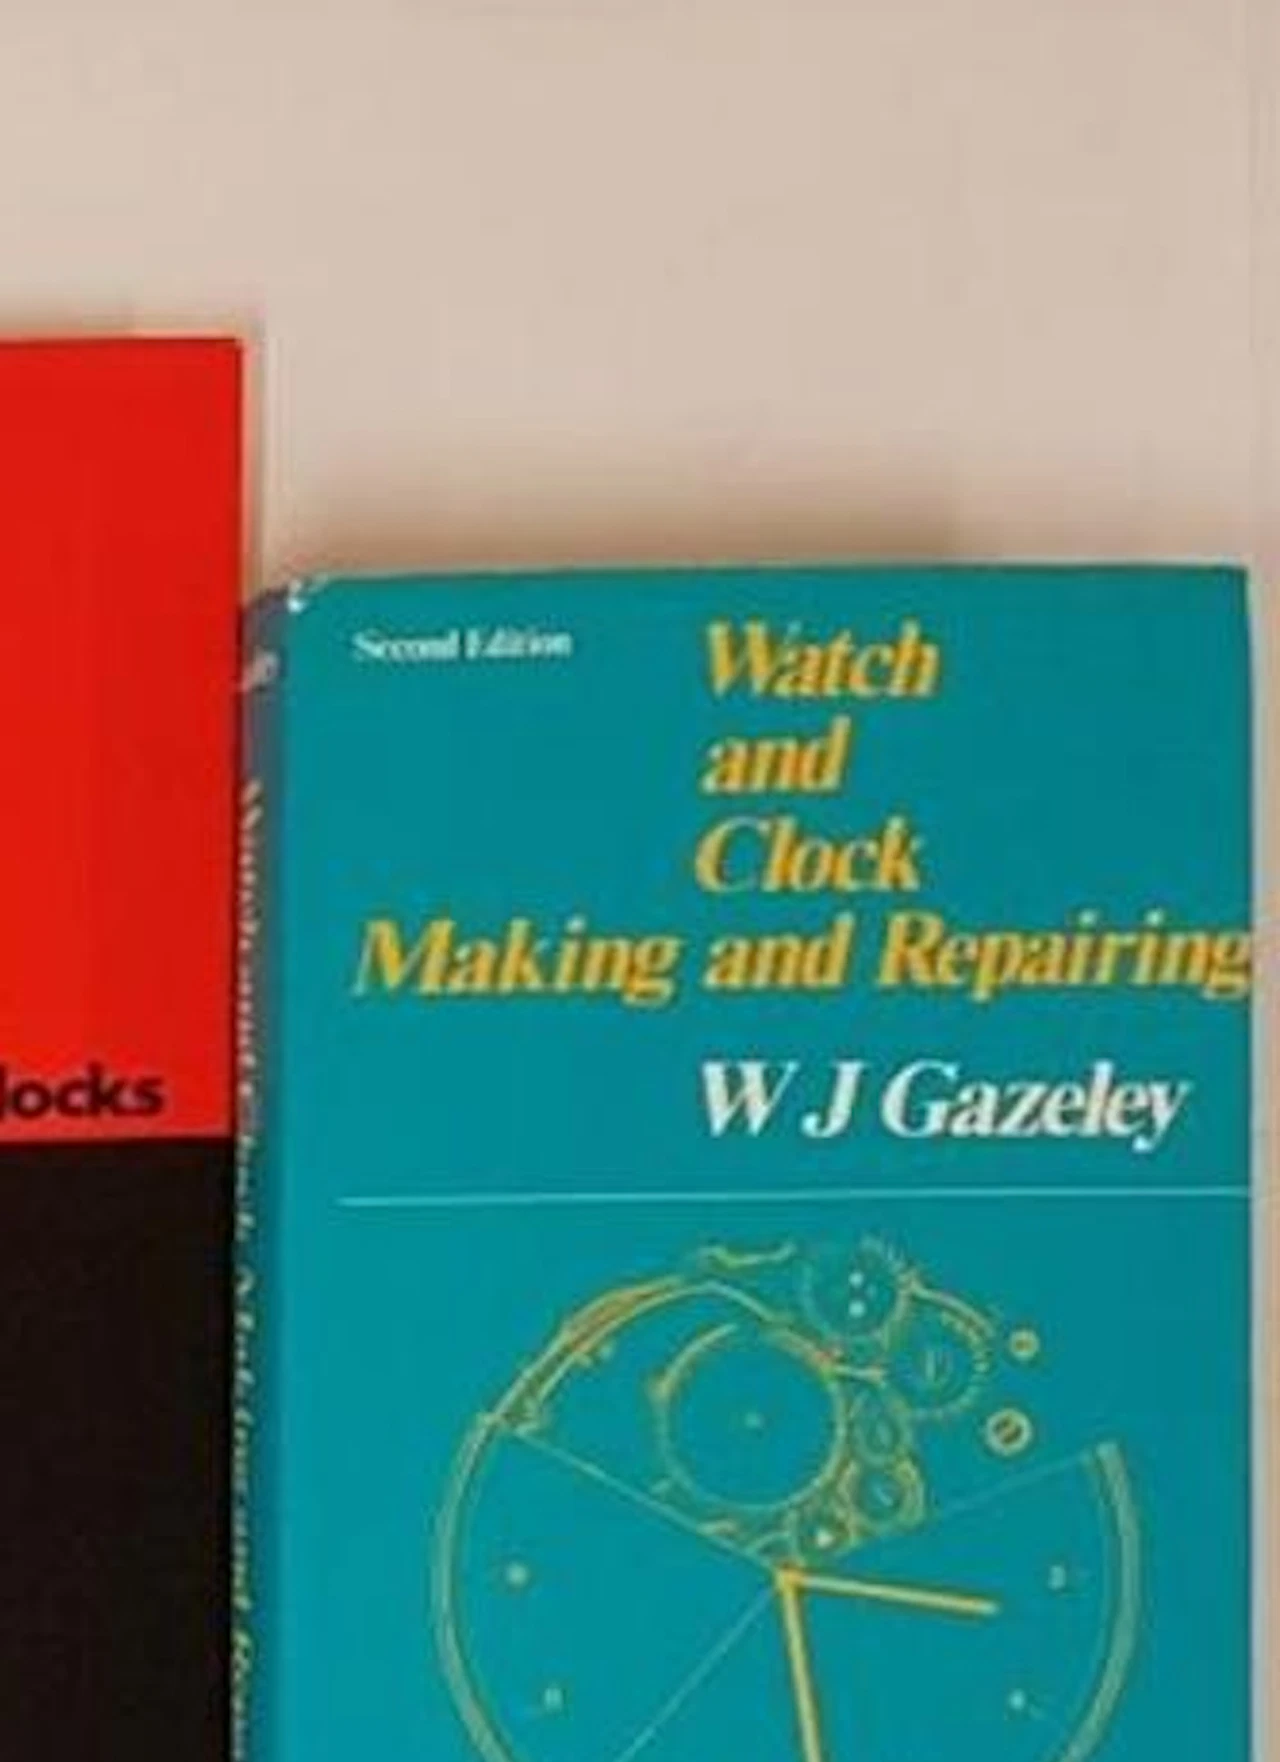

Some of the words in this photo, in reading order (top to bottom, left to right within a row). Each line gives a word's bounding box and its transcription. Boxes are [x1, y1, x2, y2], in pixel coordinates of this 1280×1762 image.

[352, 629, 459, 662] Second
[465, 627, 573, 659] Edition
[703, 618, 941, 698] Watch
[701, 717, 851, 794] and
[695, 816, 921, 893] Clock
[352, 917, 683, 1005] Making
[703, 913, 851, 989] and
[878, 909, 1253, 1000] Repairing
[700, 1059, 797, 1139] W
[803, 1058, 870, 1139] J
[881, 1059, 1191, 1152] Gazeley
